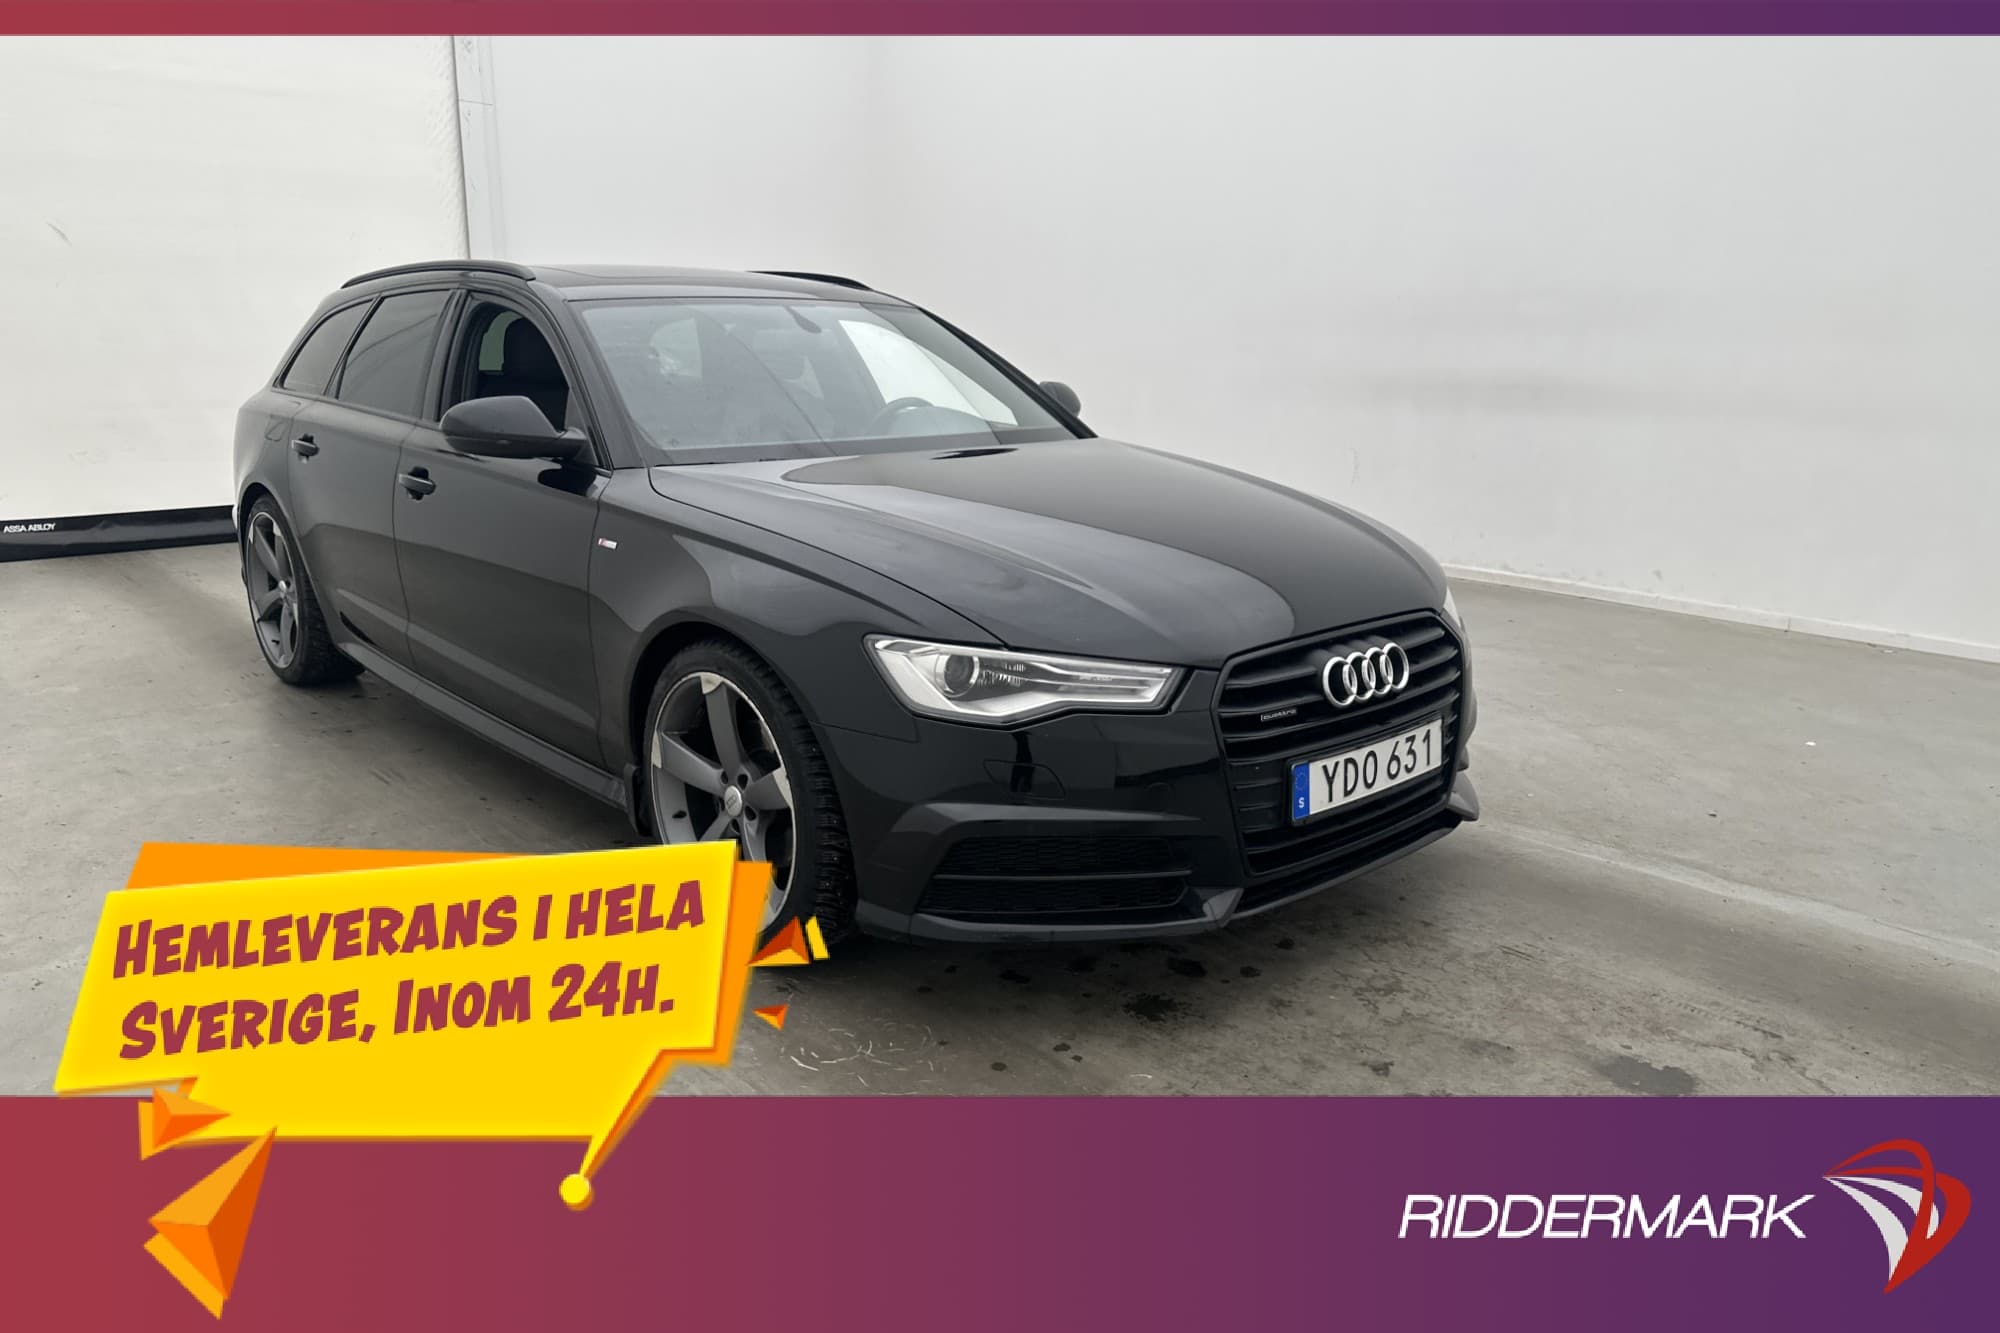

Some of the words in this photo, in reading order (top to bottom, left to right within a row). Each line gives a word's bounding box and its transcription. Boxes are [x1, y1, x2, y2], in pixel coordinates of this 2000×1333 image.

[3, 525, 27, 533] ASSA
[28, 523, 56, 532] ABLOY
[1322, 750, 1378, 803] YDO
[1387, 728, 1432, 780] 631
[1298, 796, 1305, 809] S
